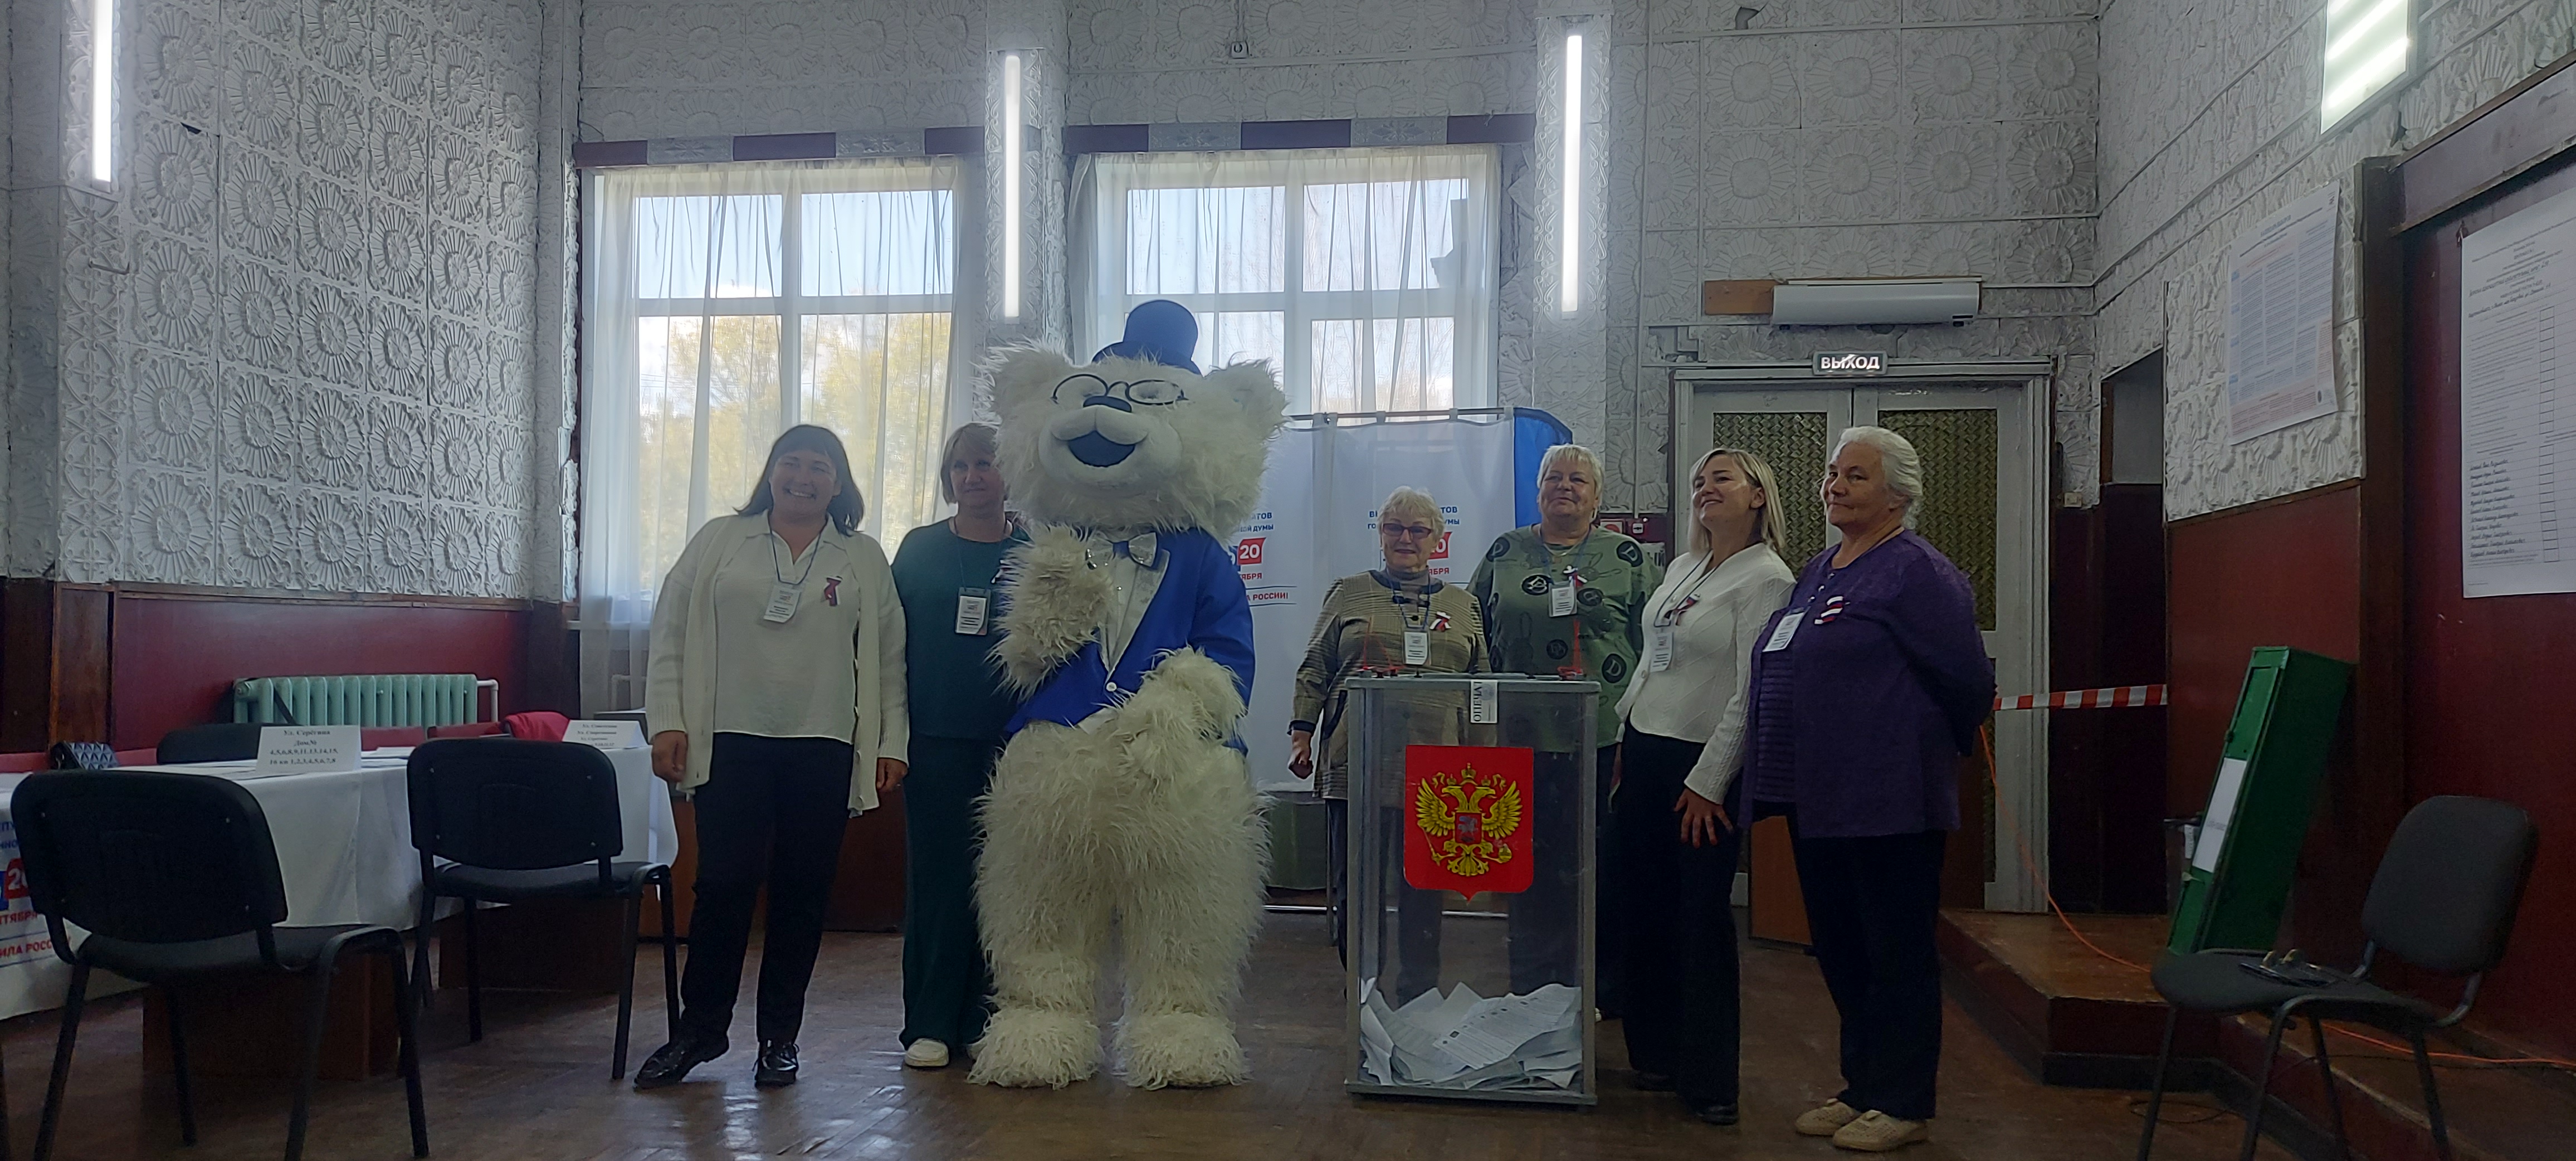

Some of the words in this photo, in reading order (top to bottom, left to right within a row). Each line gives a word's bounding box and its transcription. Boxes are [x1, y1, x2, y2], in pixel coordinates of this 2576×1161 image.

[1821, 356, 1880, 369] ВЫХОД
[1253, 524, 1274, 532] ДУМЫ
[1240, 544, 1260, 559] 20
[1253, 592, 1289, 601] РОССИИ!
